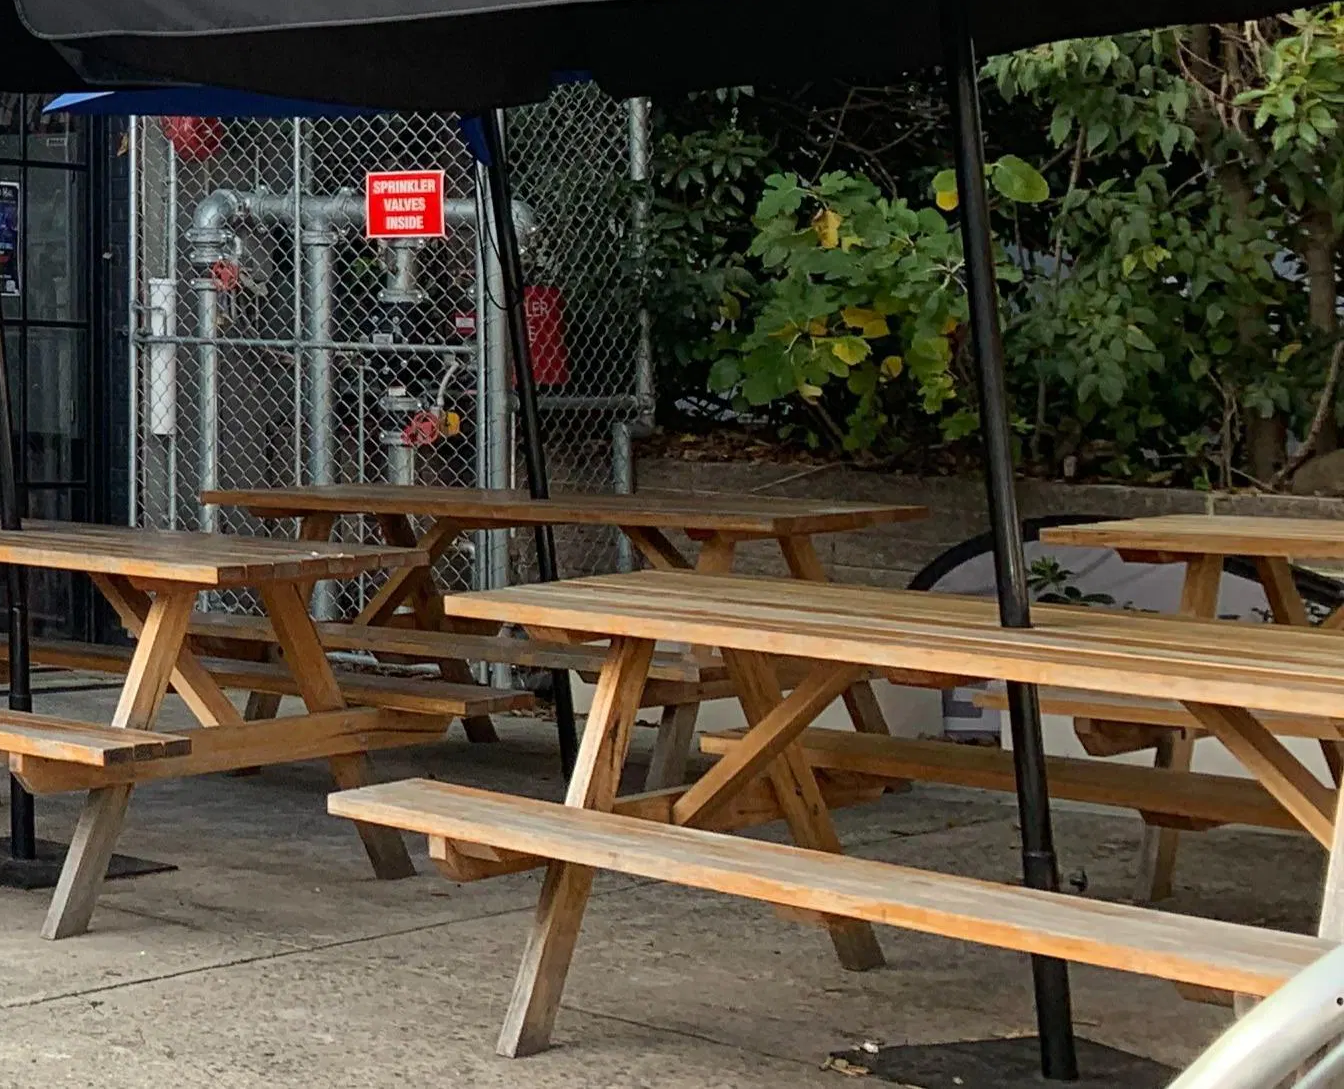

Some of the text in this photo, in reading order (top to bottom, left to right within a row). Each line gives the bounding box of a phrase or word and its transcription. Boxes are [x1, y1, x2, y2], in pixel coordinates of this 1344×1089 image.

[373, 178, 436, 194] SPRINKLER
[383, 197, 426, 213] VALVES
[385, 215, 424, 230] INSIDE
